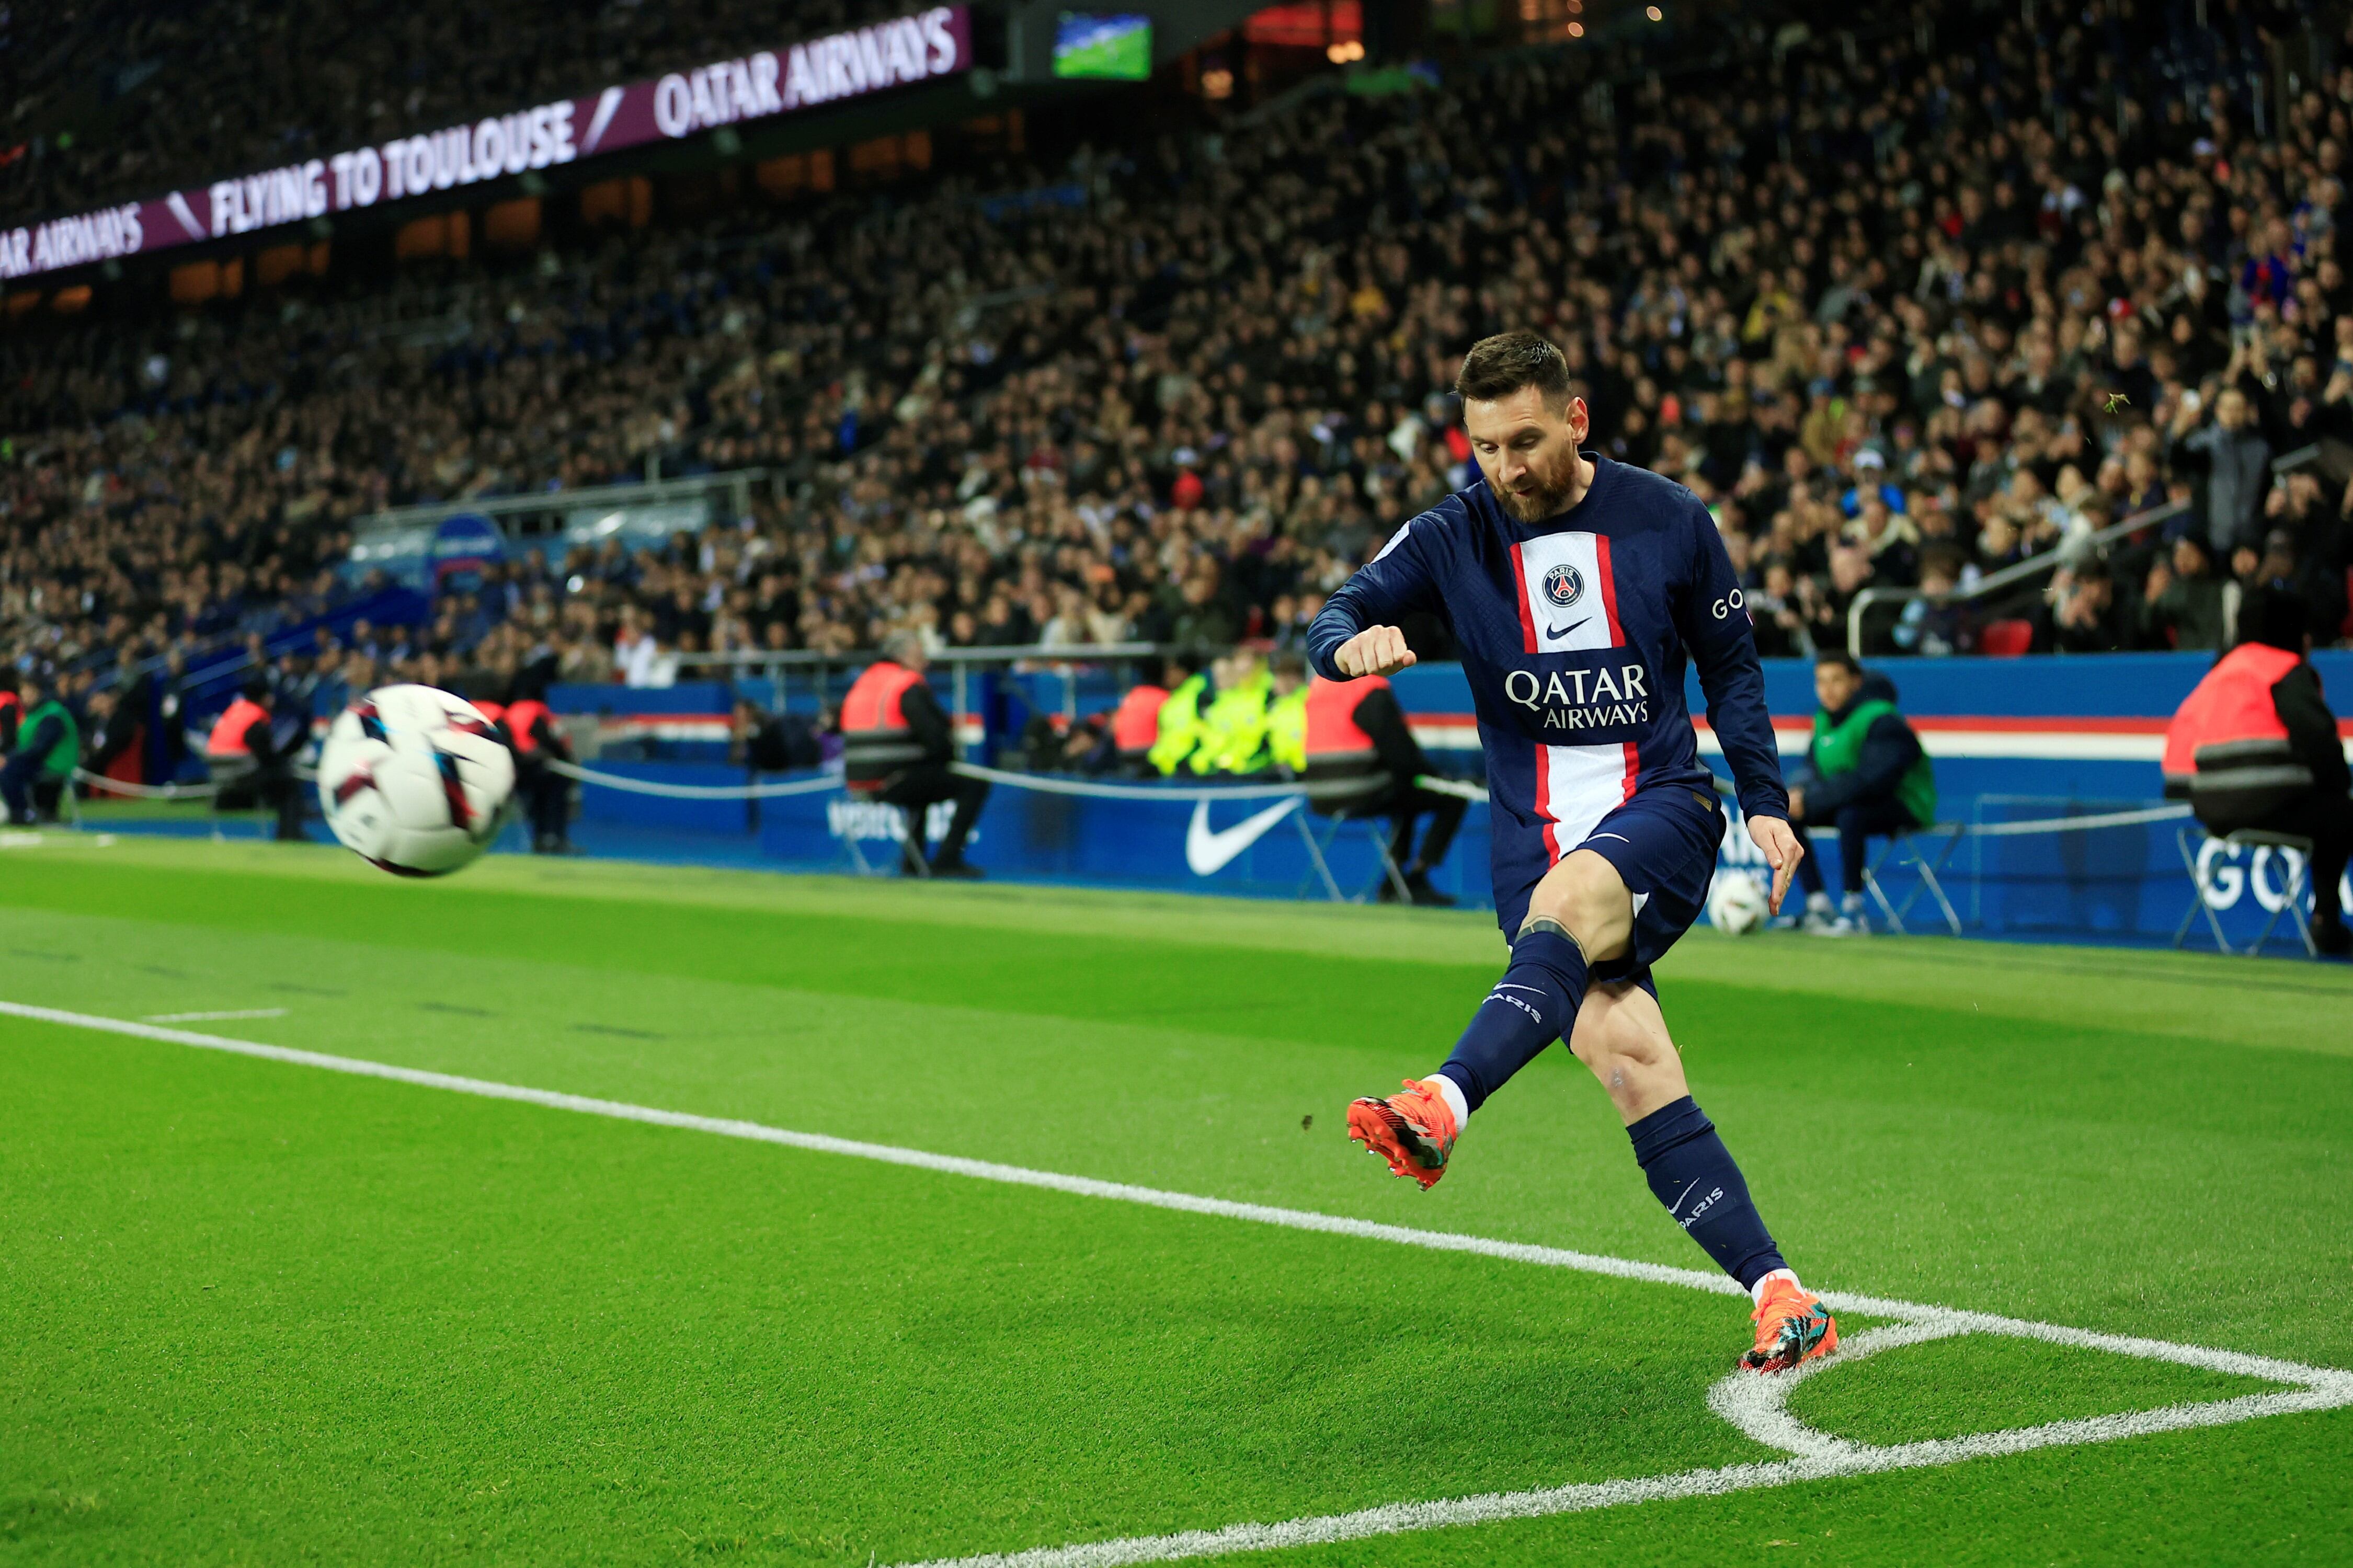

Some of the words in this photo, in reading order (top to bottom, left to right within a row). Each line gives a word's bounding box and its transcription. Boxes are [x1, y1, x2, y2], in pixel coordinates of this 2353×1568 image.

[654, 51, 784, 138] QATAR
[784, 7, 956, 108] AIRWAYS
[210, 158, 327, 237] FLYING
[330, 146, 382, 208] TO
[382, 99, 577, 197] TOULOUSE
[32, 202, 143, 269] AIRWAYS
[1548, 567, 1574, 579] PARIS
[1712, 588, 1743, 619] GO
[1505, 664, 1648, 712] QATAR
[1544, 701, 1648, 729] AIRWAYS
[1482, 993, 1542, 1024] PARIS
[1679, 1187, 1724, 1230] PARIS
